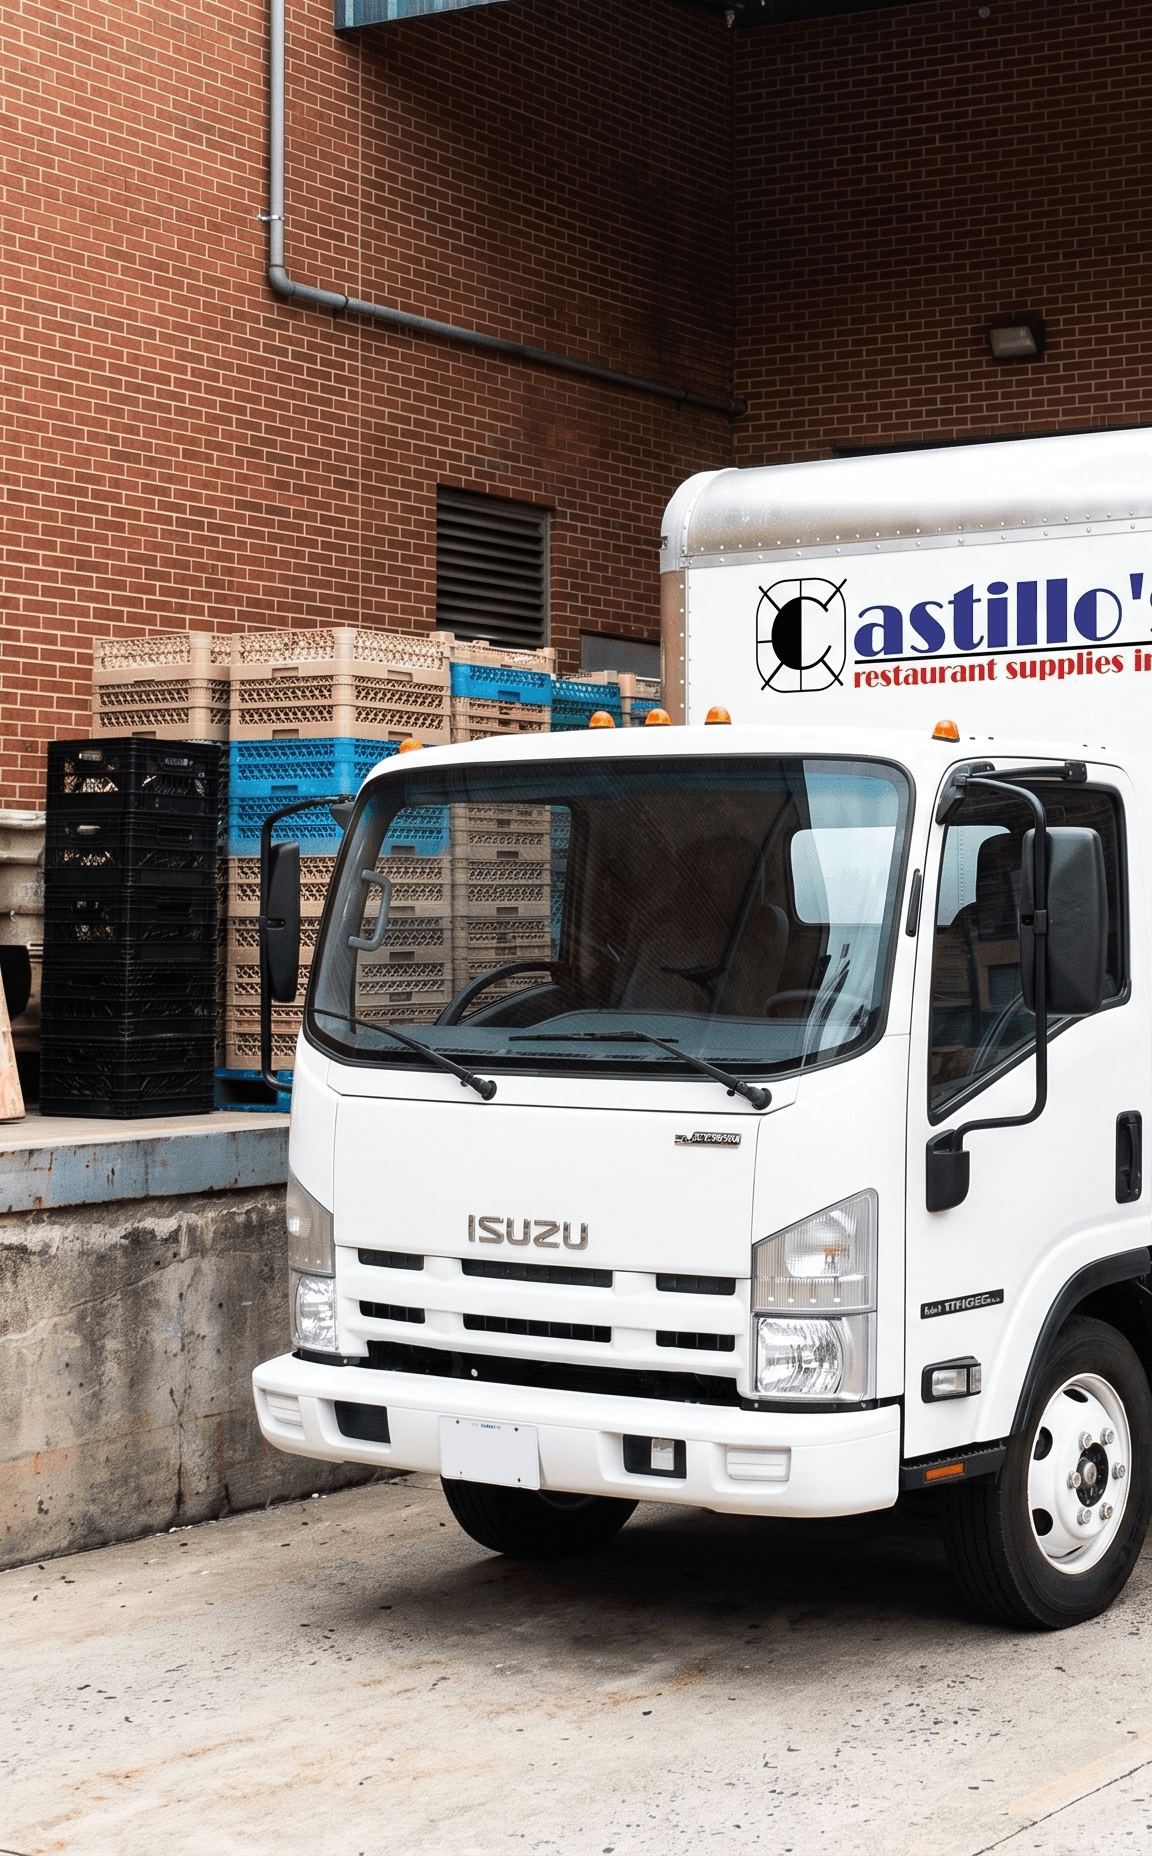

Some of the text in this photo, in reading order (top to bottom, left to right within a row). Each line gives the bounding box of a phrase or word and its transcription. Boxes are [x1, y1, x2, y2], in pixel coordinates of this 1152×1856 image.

[854, 658, 998, 689] restaurant
[1005, 651, 1124, 682] supplies
[467, 1214, 589, 1251] ISUZU
